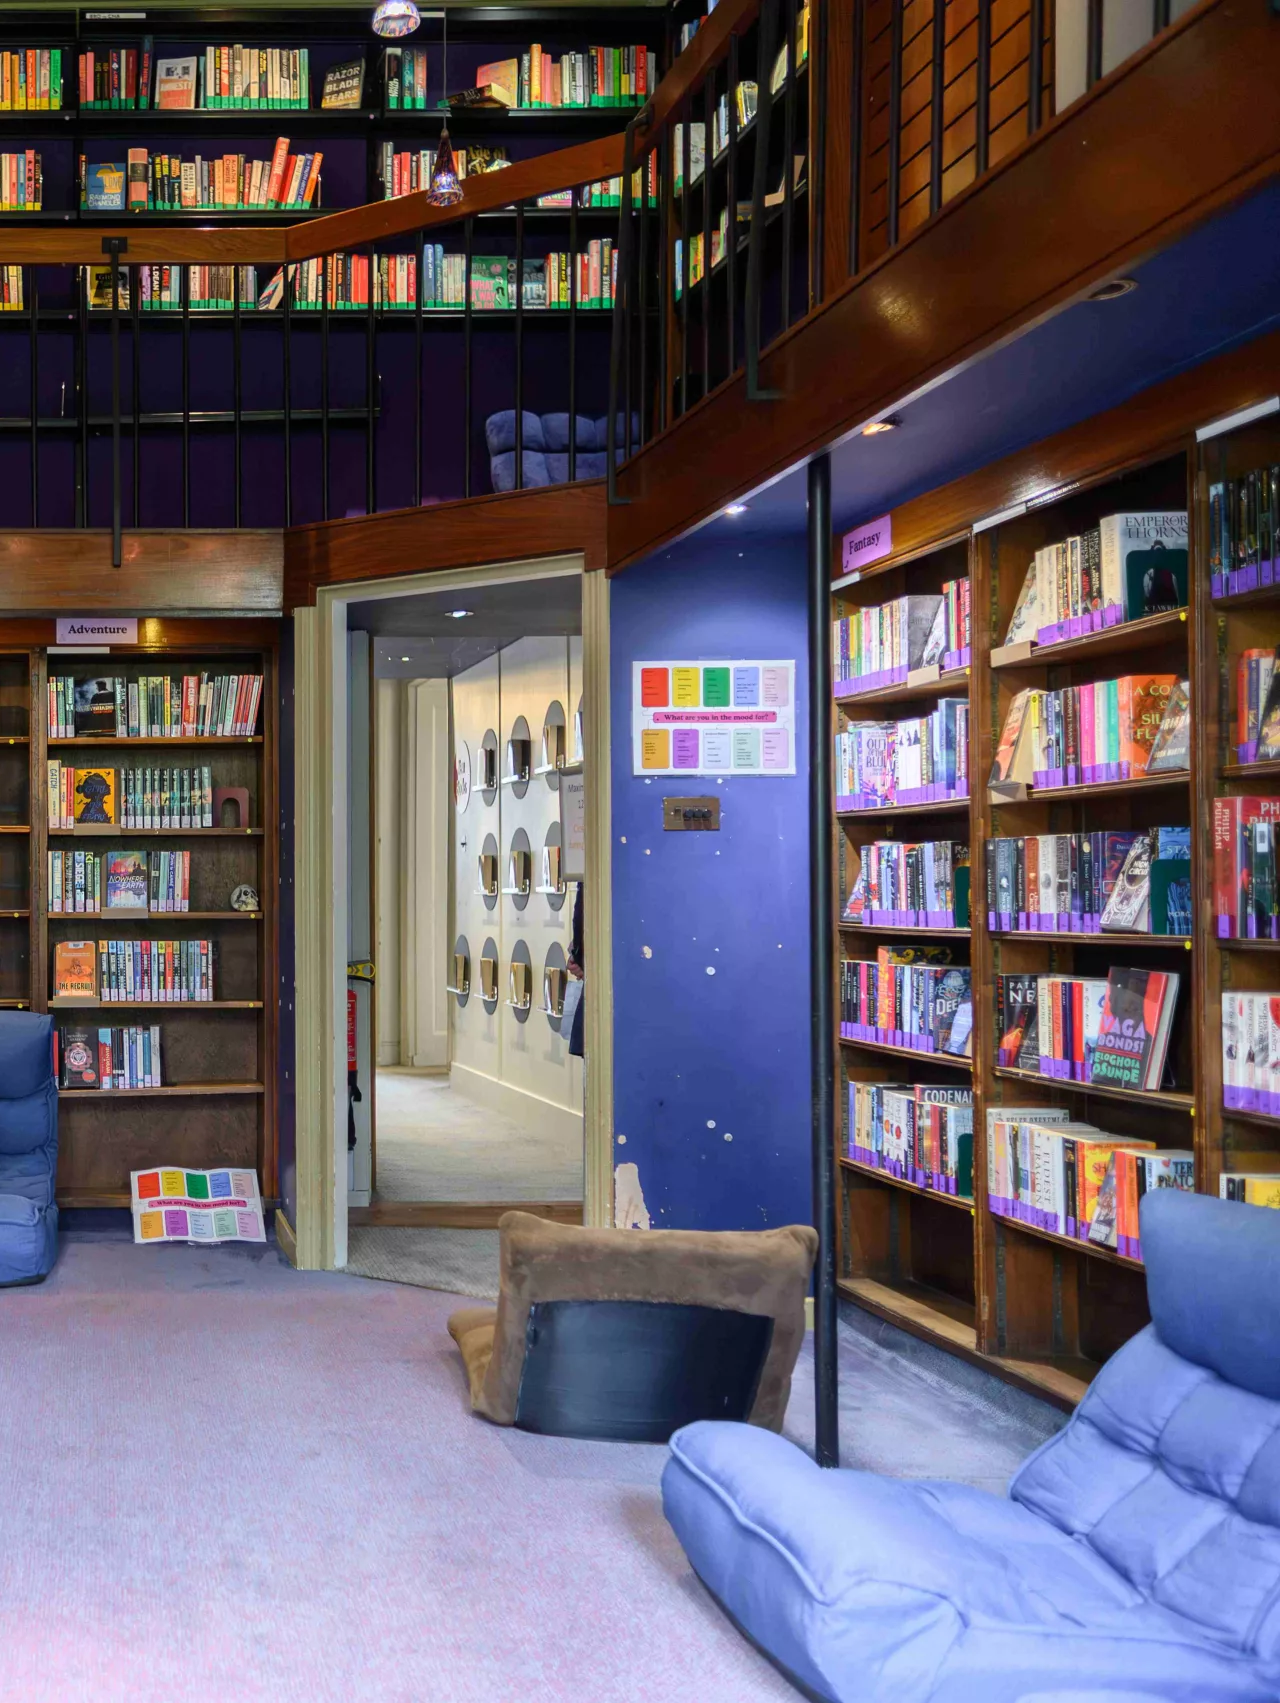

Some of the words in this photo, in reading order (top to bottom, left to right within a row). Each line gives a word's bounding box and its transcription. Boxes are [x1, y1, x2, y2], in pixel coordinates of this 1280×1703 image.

[327, 66, 360, 82] RAZOR
[326, 78, 360, 92] BLADE
[324, 89, 358, 103] TEARS
[471, 280, 495, 291] WHAT
[848, 531, 881, 555] Fantasy
[68, 624, 127, 635] Adventure
[697, 715, 709, 723] you
[733, 713, 753, 721] mood
[755, 713, 768, 721] for?
[1214, 802, 1222, 849] PULLMAN
[1222, 808, 1230, 842] PHILIP
[75, 862, 84, 884] SIEGE
[108, 874, 144, 884] NOWHERE
[120, 881, 145, 890] EARTH
[59, 981, 69, 991] THE
[70, 981, 94, 991] RECRUIT
[1009, 989, 1036, 1004] NE
[1101, 1014, 1147, 1040] VAGA
[1098, 1033, 1145, 1054] BONDS!
[1094, 1051, 1141, 1070] ELOGHOSA
[1092, 1065, 1140, 1083] OSUNDE
[1172, 1160, 1194, 1175] TER
[1042, 1151, 1051, 1204] ELDEST
[1157, 1175, 1195, 1189] PRATC
